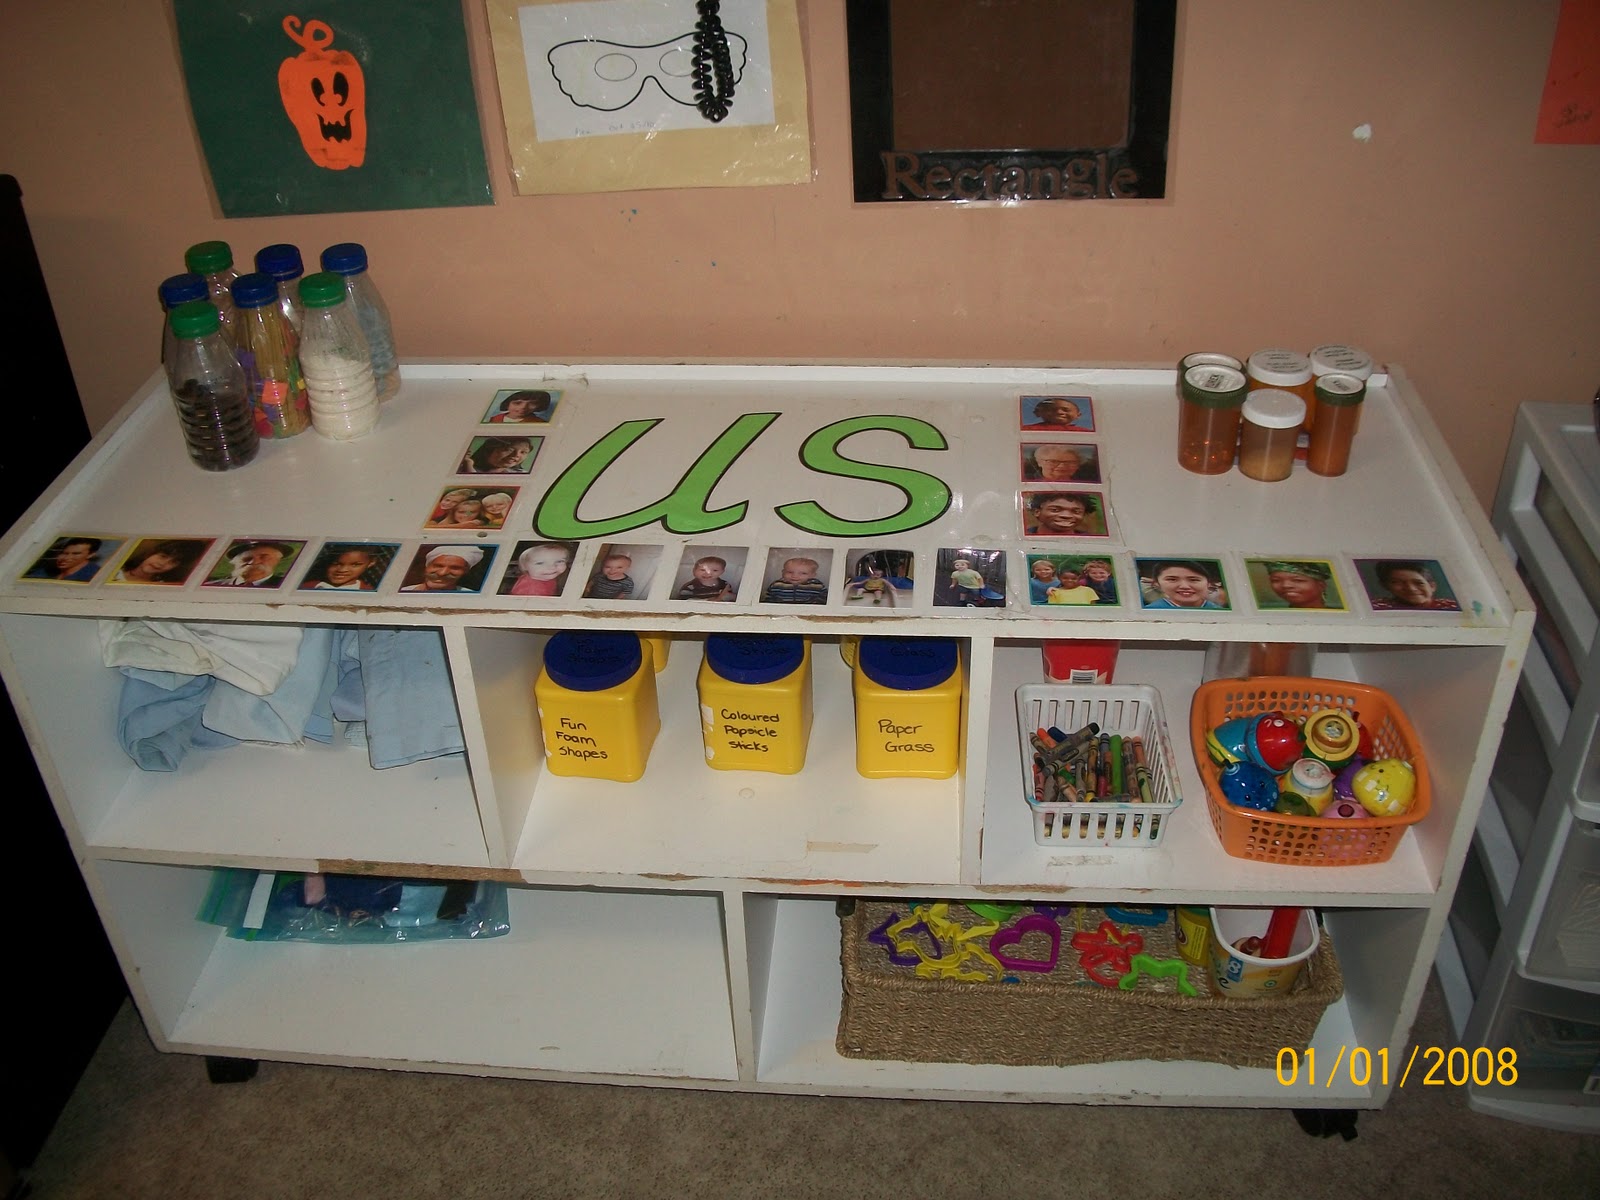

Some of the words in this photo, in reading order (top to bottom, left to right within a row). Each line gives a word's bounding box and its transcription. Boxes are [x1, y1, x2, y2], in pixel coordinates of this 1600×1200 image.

[879, 151, 1140, 200] Rectangle
[721, 708, 780, 722] Coloured
[560, 717, 587, 731] Fun
[724, 724, 778, 738] Popsicle
[878, 719, 923, 738] Paper
[555, 730, 597, 747] Foam
[558, 746, 608, 761] Shapes
[885, 741, 935, 753] Grass
